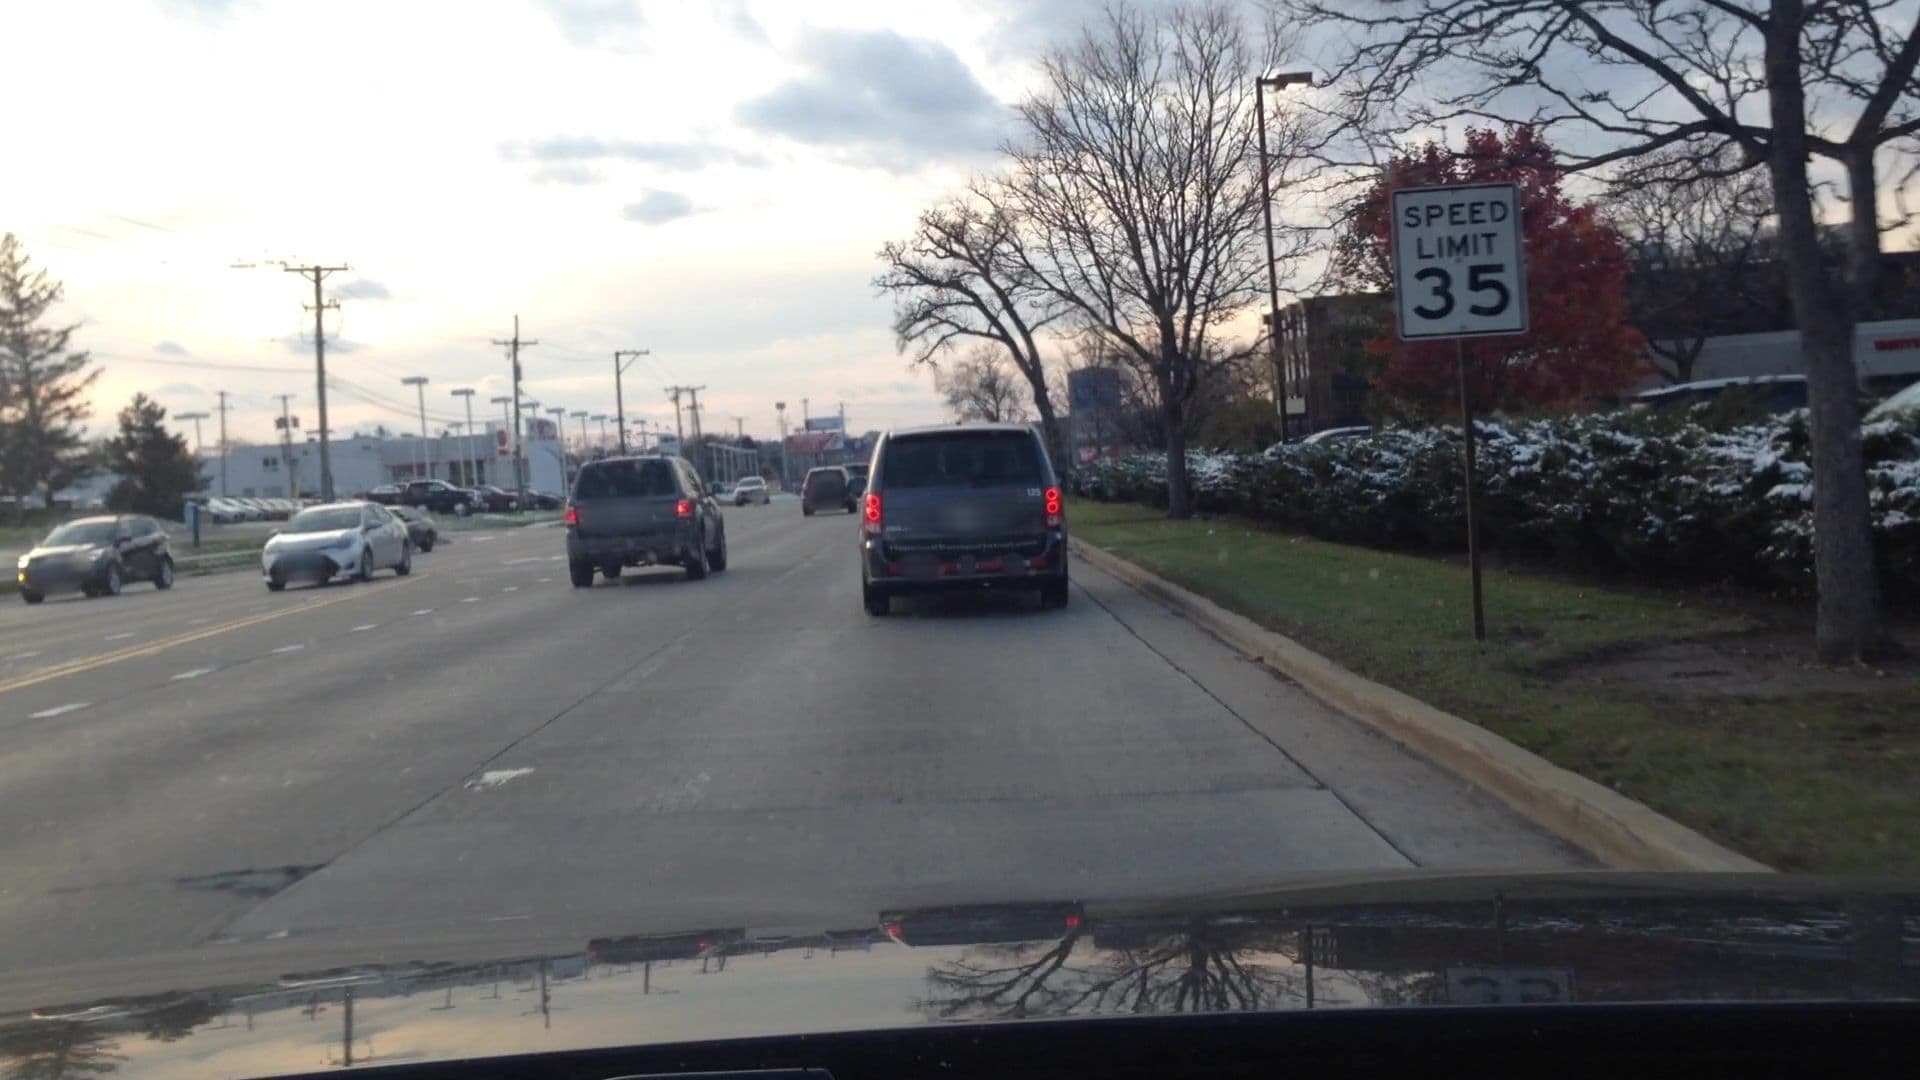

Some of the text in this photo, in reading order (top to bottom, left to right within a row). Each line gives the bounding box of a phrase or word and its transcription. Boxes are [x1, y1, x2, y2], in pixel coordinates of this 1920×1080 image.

[1404, 201, 1508, 228] SPEED
[1416, 232, 1498, 260] LIMIT
[1413, 263, 1511, 320] 35
